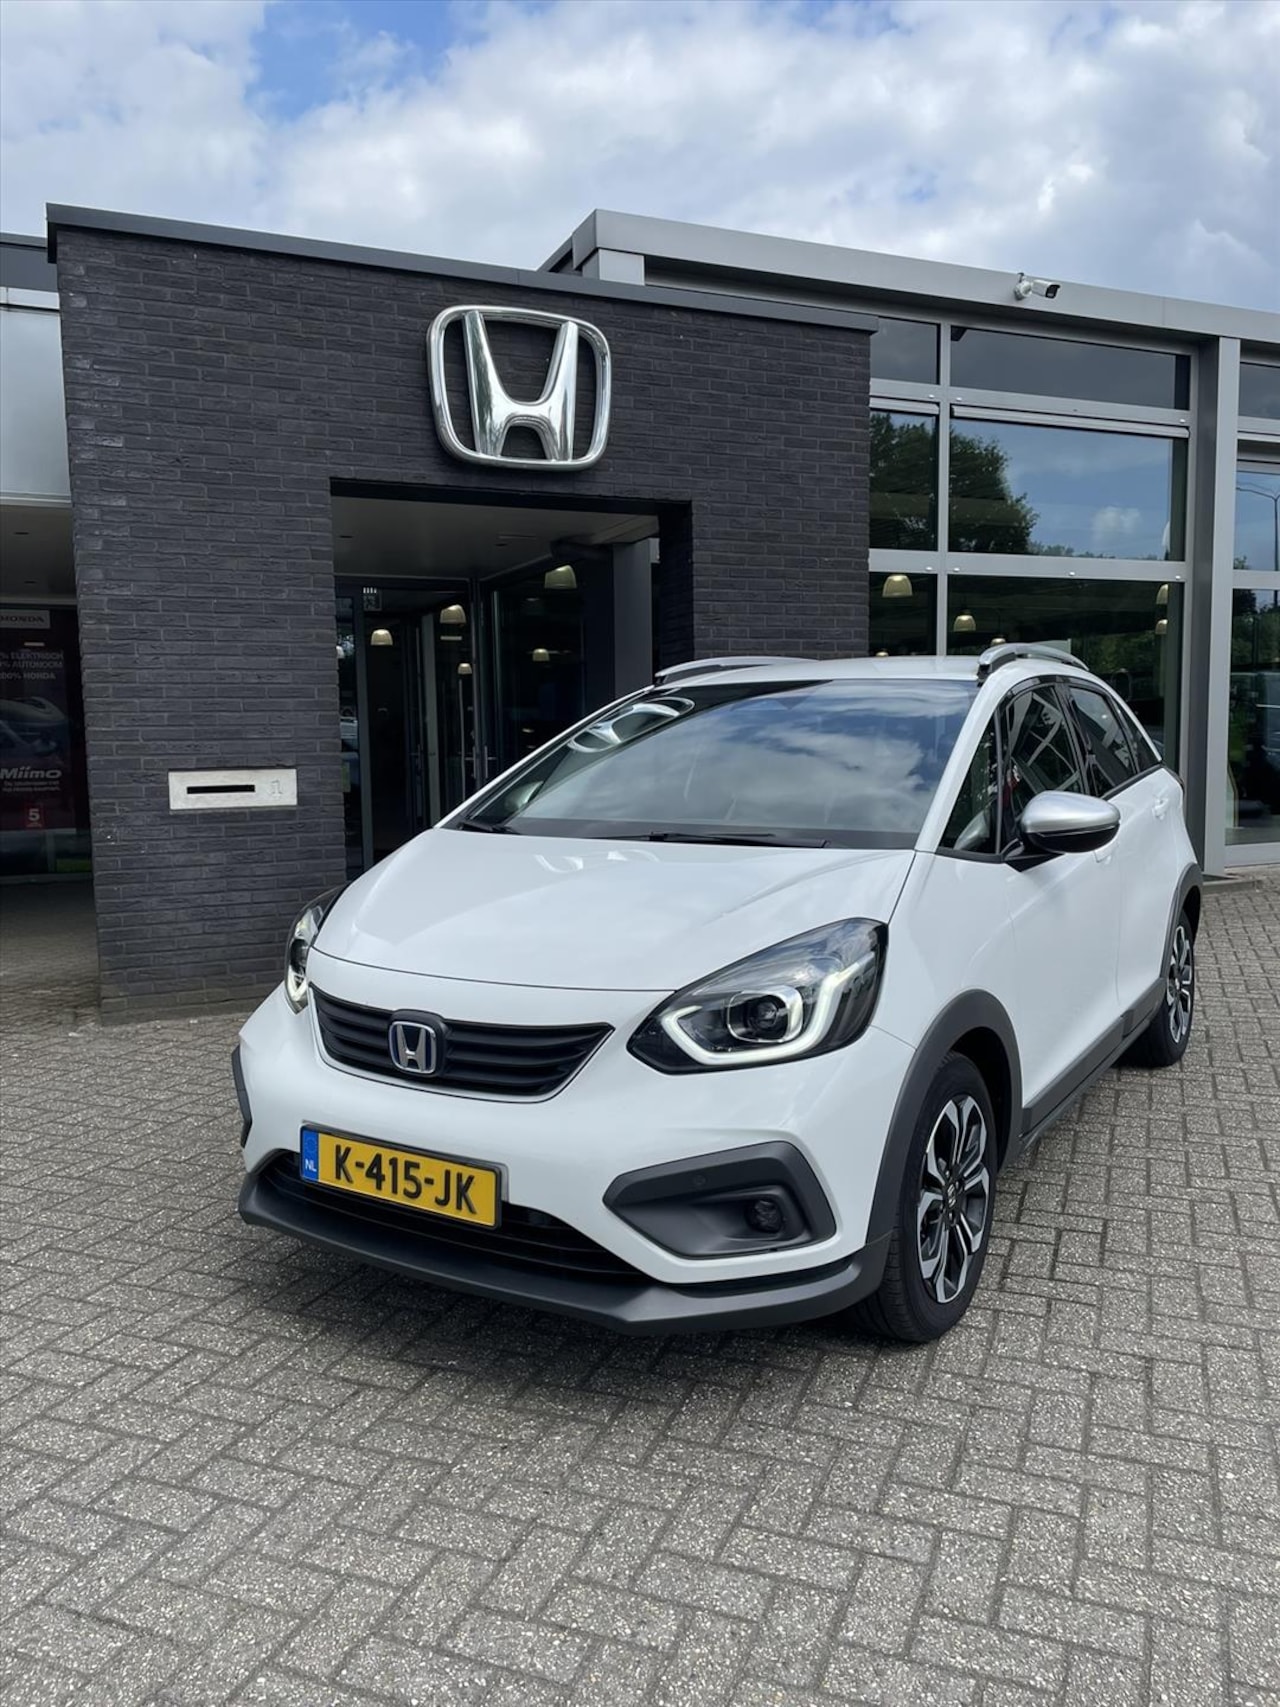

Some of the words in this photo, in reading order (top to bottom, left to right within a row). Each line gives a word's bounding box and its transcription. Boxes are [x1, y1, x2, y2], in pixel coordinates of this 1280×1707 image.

[0, 615, 44, 623] HONDA
[23, 671, 56, 680] HONDA
[0, 766, 62, 779] Miimo
[28, 808, 41, 821] 5
[304, 1158, 317, 1172] NL
[334, 1143, 477, 1215] K-415-JK
